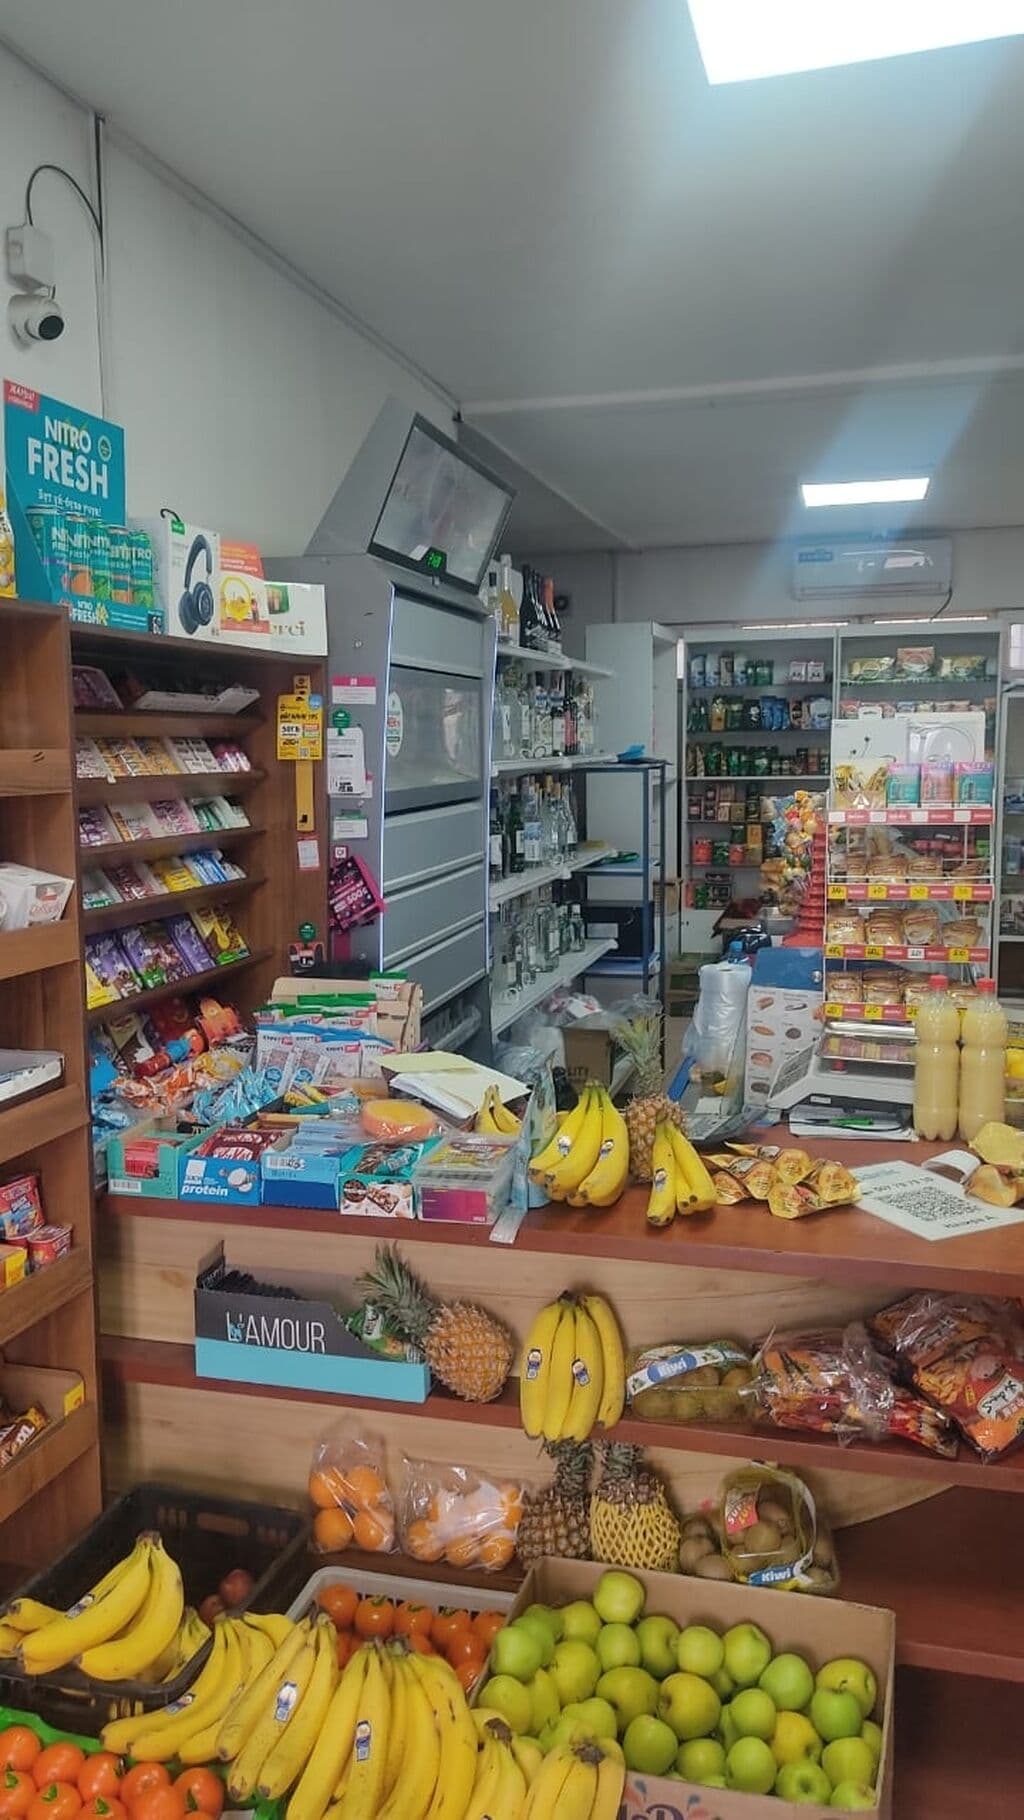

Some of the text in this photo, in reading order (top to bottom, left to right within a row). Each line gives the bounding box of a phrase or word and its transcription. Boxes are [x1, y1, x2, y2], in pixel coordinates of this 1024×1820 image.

[44, 415, 92, 453] NITRO
[27, 436, 109, 499] FRESH
[181, 1184, 229, 1197] protein
[226, 1311, 326, 1354] L'AMOUR
[761, 1566, 792, 1583] Kiwi
